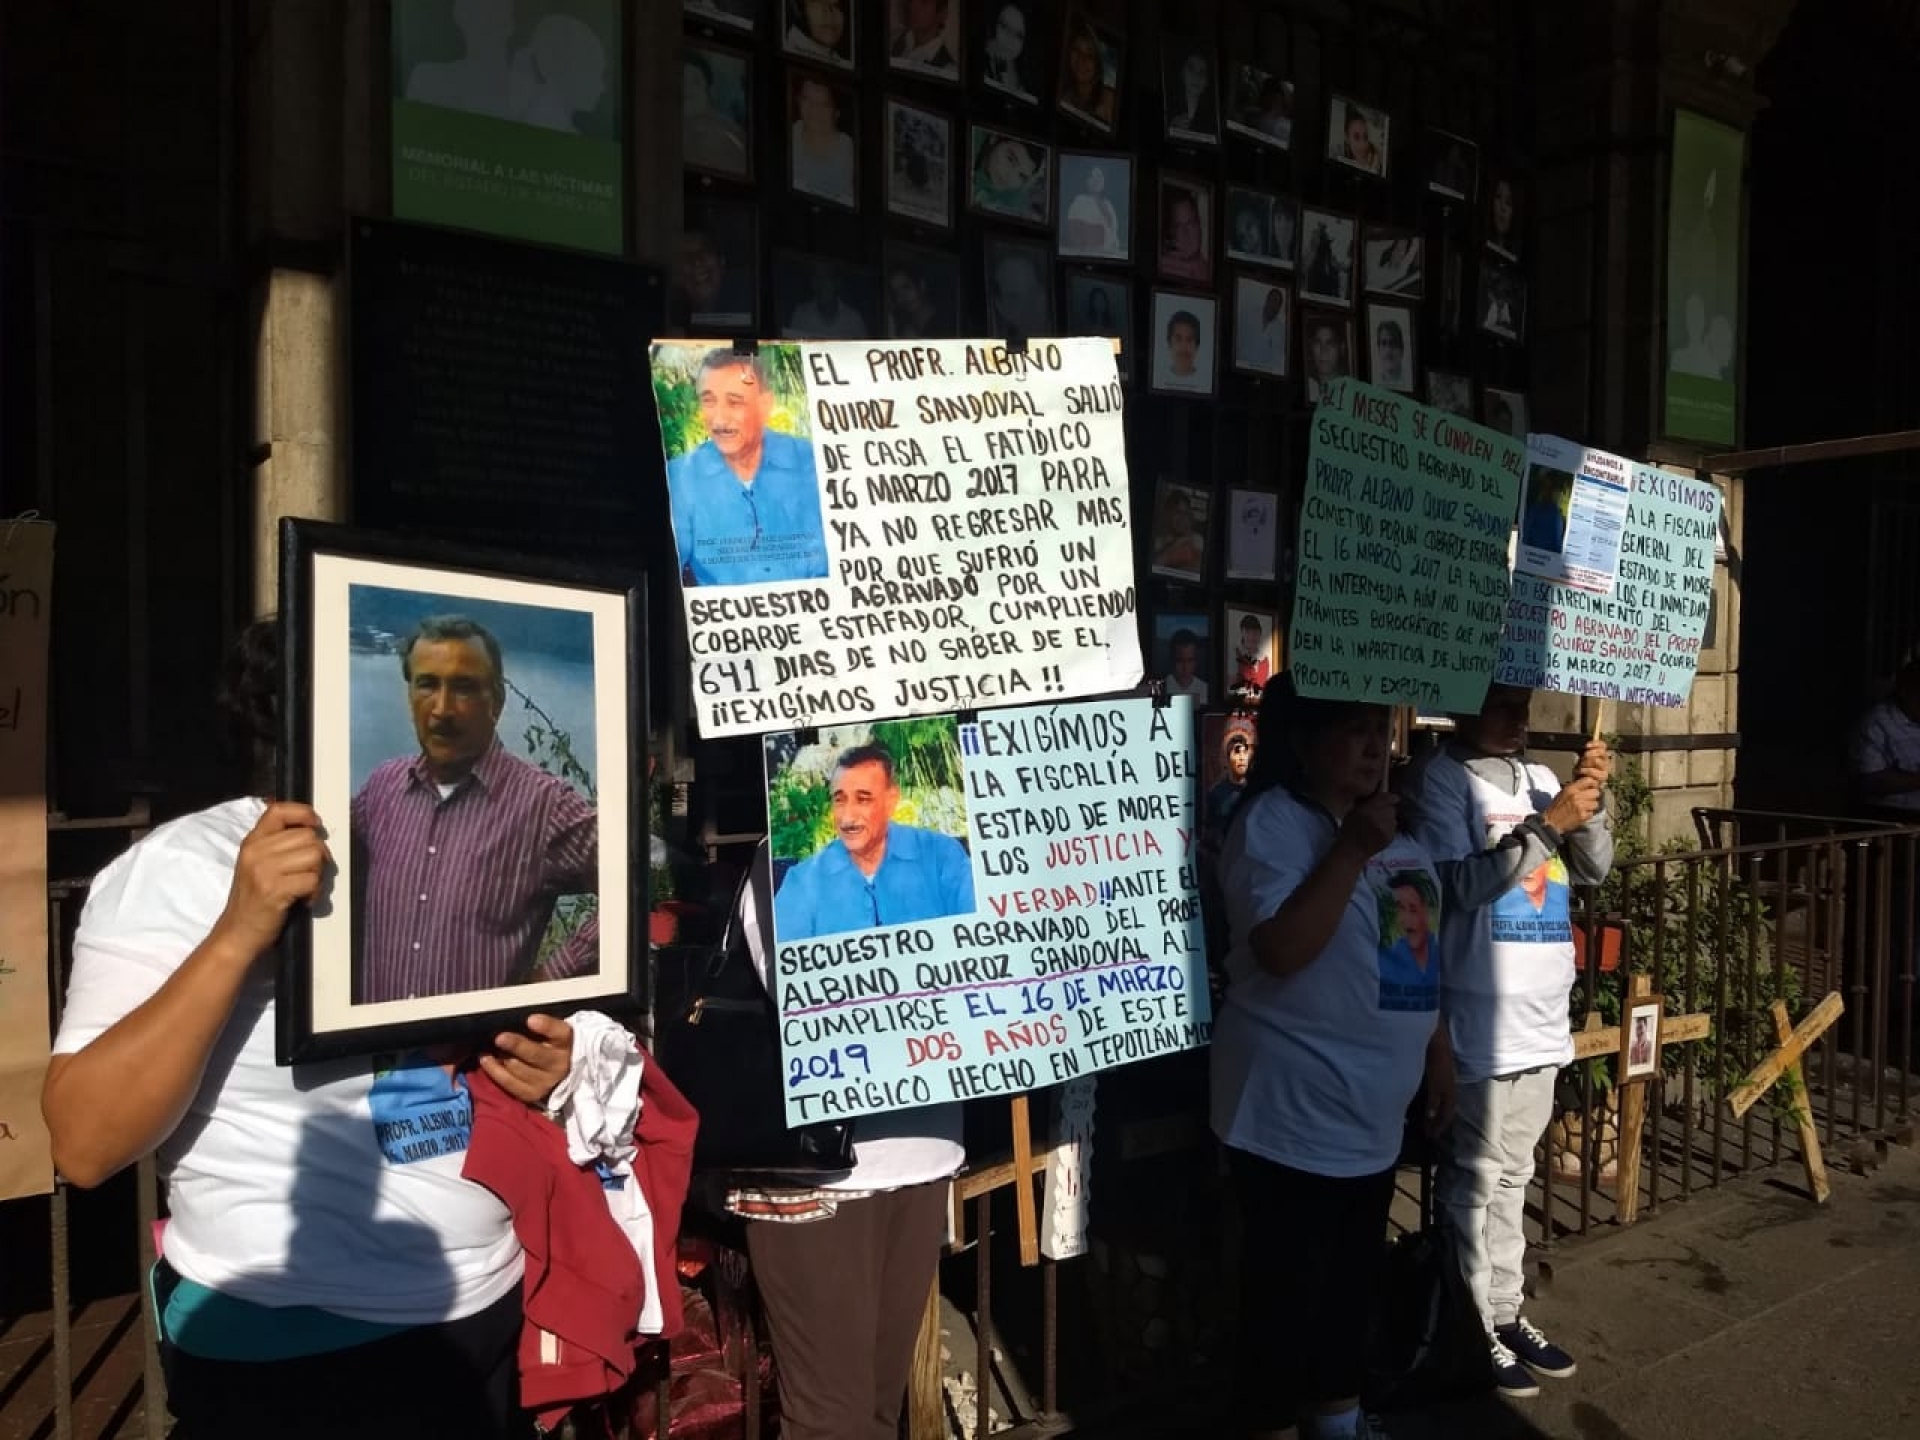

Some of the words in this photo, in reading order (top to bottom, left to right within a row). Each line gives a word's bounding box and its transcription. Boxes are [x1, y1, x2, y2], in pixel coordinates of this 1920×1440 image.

[810, 352, 849, 387] EL
[866, 348, 954, 383] PROFR.
[965, 343, 1062, 377] ALBINO
[818, 397, 898, 433] QUIROZ
[916, 389, 1045, 425] SANDOVAL
[1064, 375, 1123, 414] SALIÓ
[1352, 391, 1402, 433] MESES
[1413, 409, 1429, 441] SE
[822, 443, 851, 473] DE
[864, 438, 928, 468] CASA
[944, 435, 972, 464] EL
[985, 420, 1091, 459] FATÍDICO
[1317, 417, 1409, 471] SECUESTRO
[1481, 473, 1504, 500] DEL
[826, 477, 858, 511] 16
[866, 471, 952, 506] MARZO
[966, 463, 1018, 497] 2017
[1041, 456, 1111, 492] PARA
[1360, 473, 1415, 513] ALBINO
[830, 518, 870, 552] YA
[881, 514, 918, 545] NO
[932, 504, 1059, 543] REGRESAR
[1626, 504, 1635, 524] A
[1641, 508, 1656, 531] LA
[839, 557, 884, 587] POR
[896, 551, 943, 585] QUE
[956, 539, 1039, 577] SUFRIÓ
[1061, 536, 1096, 563] UN
[1304, 529, 1323, 561] EL
[1334, 534, 1349, 561] 16
[1355, 540, 1402, 574] MARZO
[1410, 553, 1441, 580] 2017
[1448, 564, 1462, 588] LA
[1620, 530, 1671, 562] GENERAL
[1683, 546, 1705, 569] DEL
[689, 587, 830, 626] SECUESTRO
[850, 574, 979, 610] AGRAVADO
[997, 569, 1046, 599] POR
[1061, 565, 1101, 591] UN
[1298, 563, 1324, 592] CIA
[1443, 593, 1459, 613] NO
[1616, 582, 1637, 608] LOS
[1642, 589, 1655, 609] EL
[1619, 559, 1660, 586] ESTADO
[1663, 570, 1677, 590] DE
[692, 617, 802, 656] COBARDE
[820, 601, 975, 642] ESTAFADOR,
[989, 585, 1136, 625] CUMPLIENDO
[1575, 615, 1639, 646] AGRAVADO
[1643, 632, 1661, 649] DEL
[1650, 612, 1671, 633] DEL
[698, 661, 760, 696] 641
[773, 651, 837, 687] DIAS
[846, 643, 877, 673] DE
[889, 638, 927, 665] NO
[938, 628, 1023, 661] SABER
[1032, 629, 1061, 653] DE
[1295, 629, 1322, 652] DEN
[1430, 649, 1450, 669] DE
[1525, 648, 1540, 664] EL
[1547, 652, 1560, 668] 16
[1566, 656, 1616, 677] MARZO
[1552, 633, 1597, 654] QUIROZ
[1599, 641, 1658, 664] SANDOVAL
[894, 672, 1031, 708] JUSTICIA
[1294, 662, 1350, 691] PRONTA
[1363, 674, 1373, 691] Y
[1149, 708, 1172, 742] A
[971, 769, 1005, 799] LA
[1017, 750, 1139, 794] FISCALÍA
[1155, 751, 1197, 783] DEL
[975, 806, 1071, 841] ESTADO
[1079, 801, 1108, 829] DE
[982, 847, 1030, 878] LOS
[1045, 830, 1163, 871] JUSTICIA
[1182, 826, 1198, 858] Y
[779, 930, 934, 976] SECUESTRO
[953, 914, 1091, 951] AGRAVADO
[1106, 904, 1145, 935] DEL
[782, 968, 900, 1013] ALBINO
[915, 954, 1014, 991] QUIROZ
[1031, 937, 1151, 979] SANDOVAL
[1161, 930, 1200, 956] AL
[782, 1000, 949, 1048] CUMPLIRSE
[967, 992, 1006, 1020] EL
[1021, 985, 1055, 1015] 16
[1064, 976, 1097, 1010] DE
[1098, 965, 1185, 996] MARZO
[788, 1043, 871, 1087] 2019
[905, 1032, 963, 1068] DOS
[983, 1014, 1068, 1057] AÑOS
[1078, 1007, 1107, 1038] DE
[1122, 994, 1189, 1025] ESTE
[788, 1074, 931, 1120] TRÁGICO
[948, 1058, 1036, 1099] HECHO
[1052, 1047, 1078, 1082] EN
